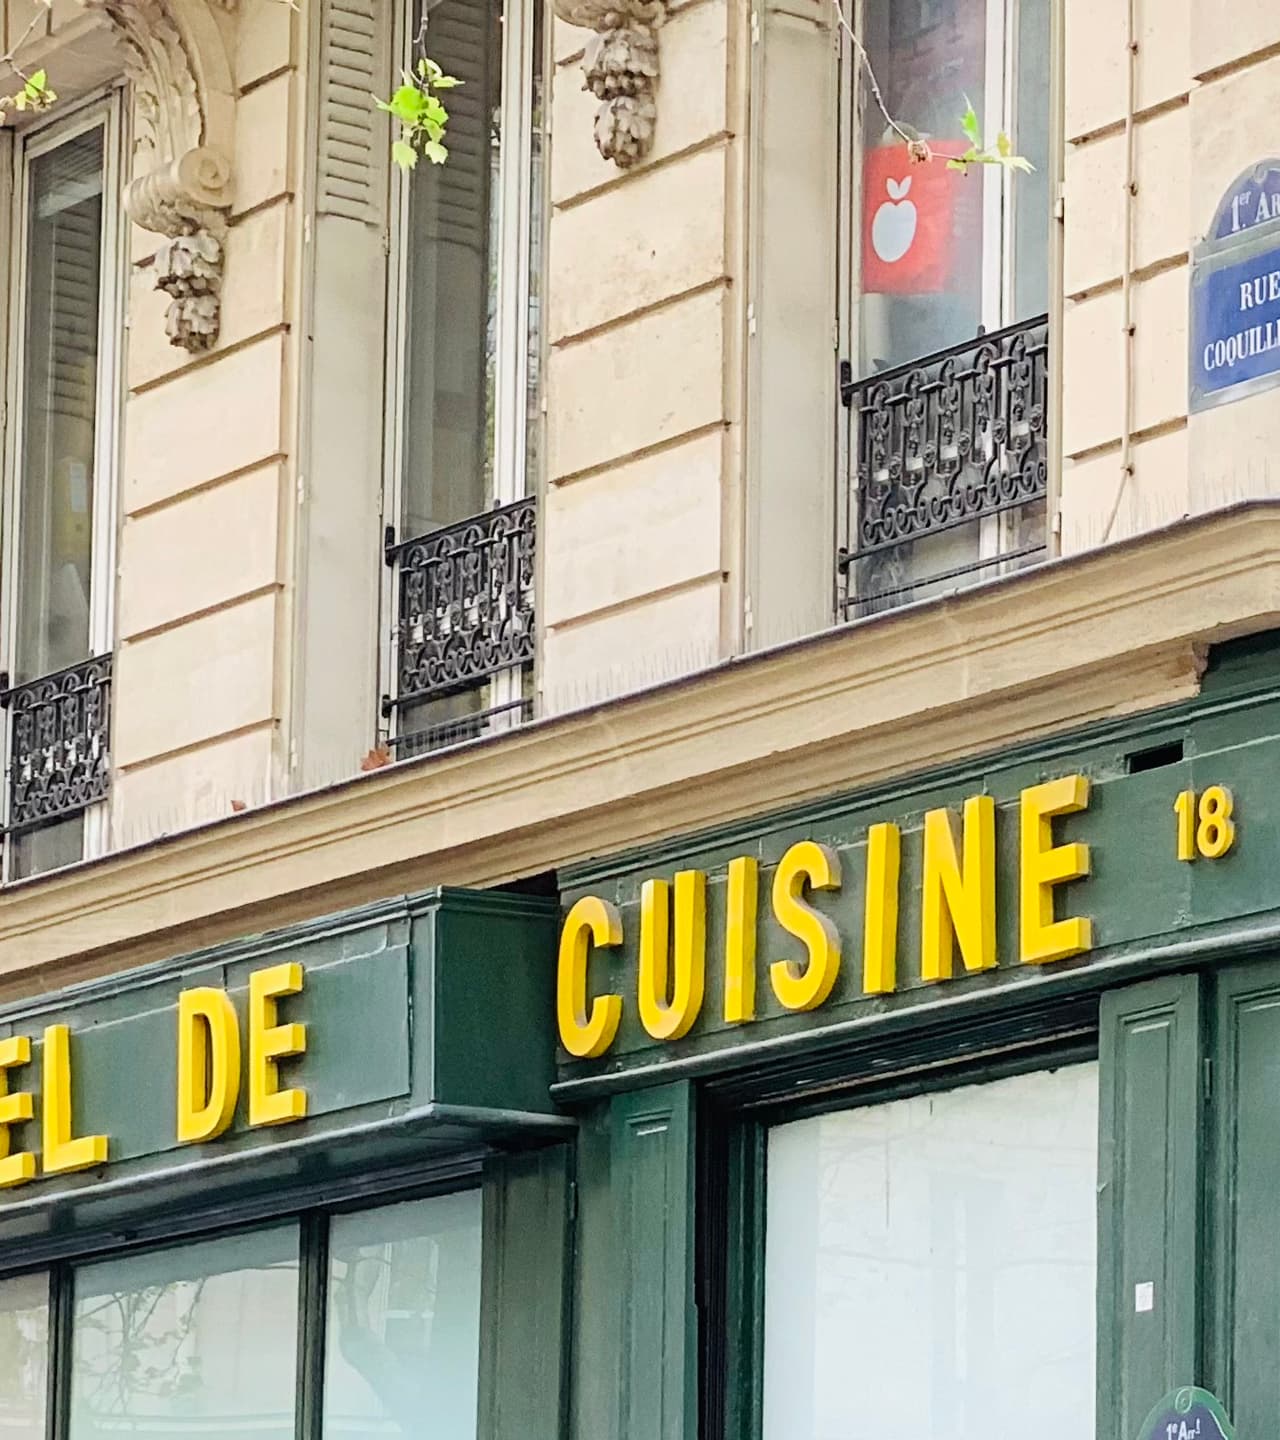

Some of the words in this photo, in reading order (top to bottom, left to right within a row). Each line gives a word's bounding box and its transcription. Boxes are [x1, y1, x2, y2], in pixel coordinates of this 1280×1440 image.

[1240, 271, 1280, 311] RUE
[1173, 785, 1235, 862] 18
[556, 774, 1093, 1059] CUISINE
[177, 962, 307, 1142] DE
